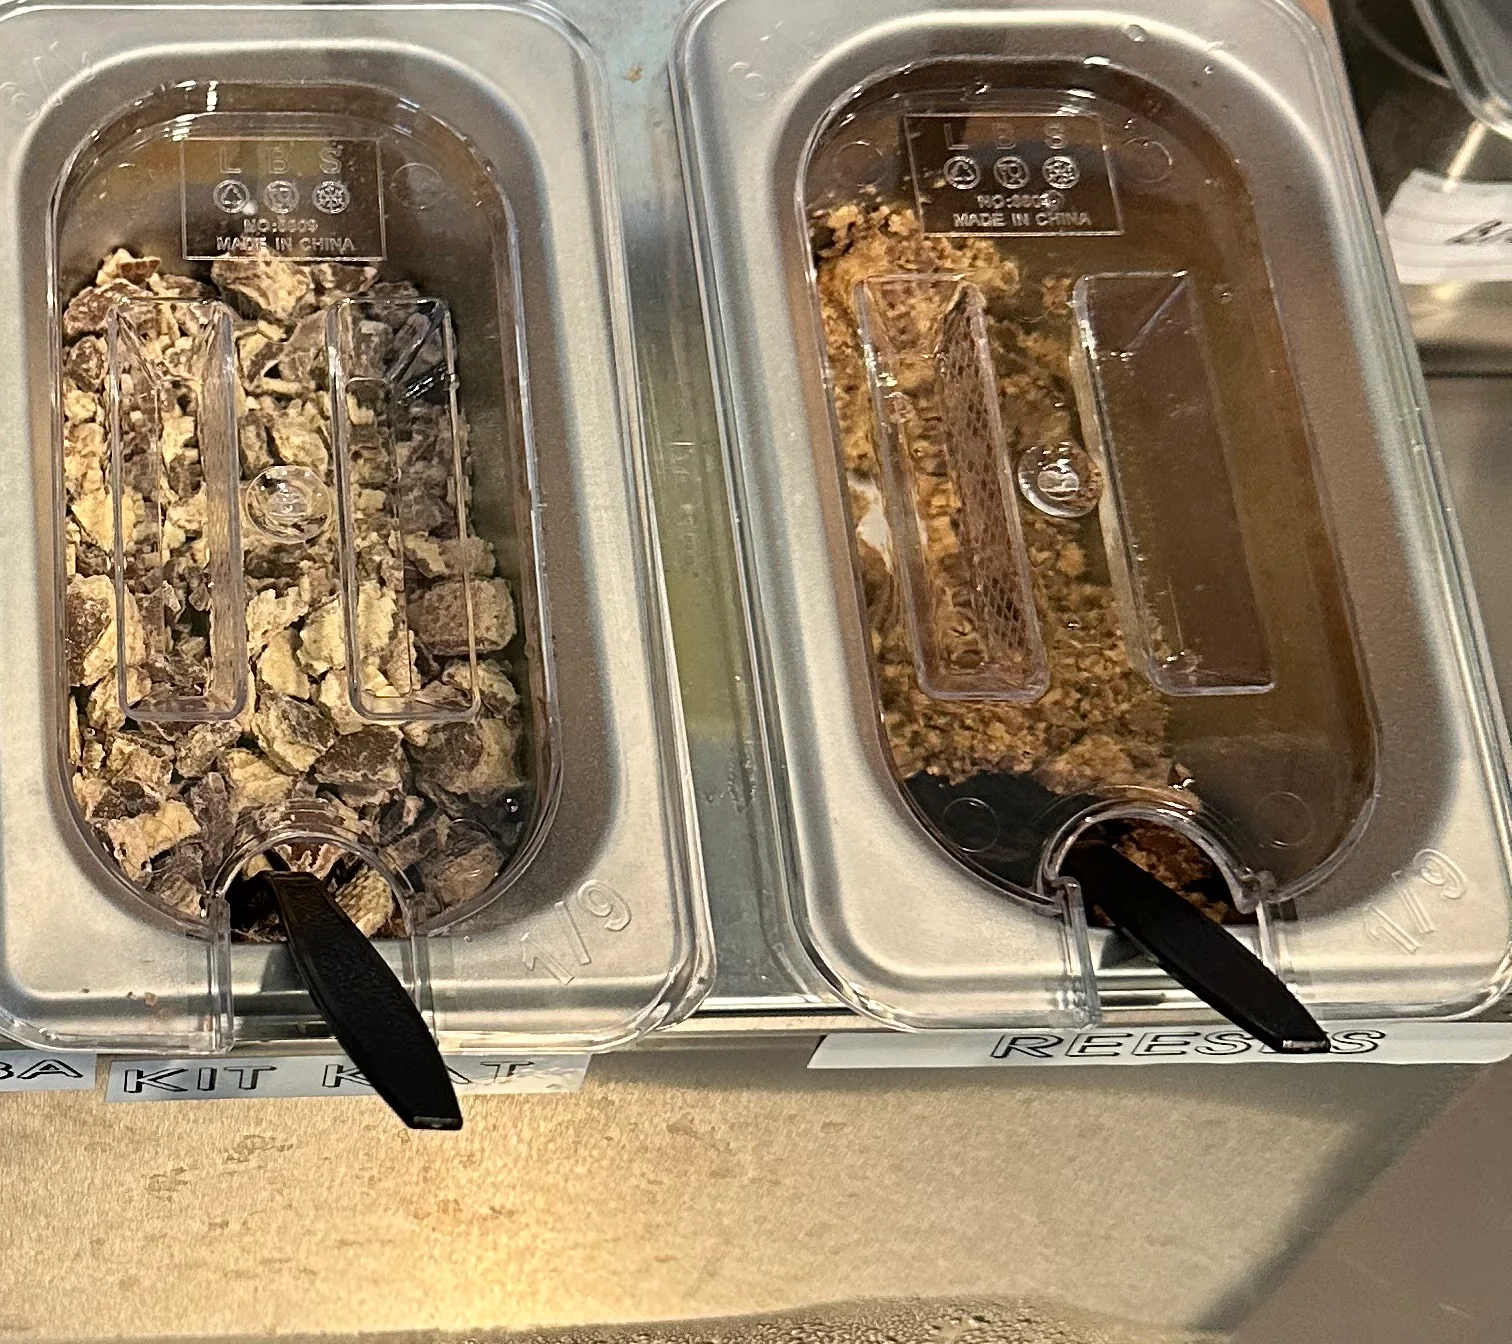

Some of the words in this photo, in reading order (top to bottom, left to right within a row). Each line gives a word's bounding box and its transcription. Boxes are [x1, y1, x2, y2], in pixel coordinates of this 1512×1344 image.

[952, 212, 1007, 227] MADE
[1011, 212, 1030, 227] IN
[274, 236, 293, 252] IN
[298, 236, 356, 253] CHINA
[519, 878, 632, 985] 1/9
[990, 1029, 1387, 1058] REESS
[123, 1064, 278, 1094] KIT
